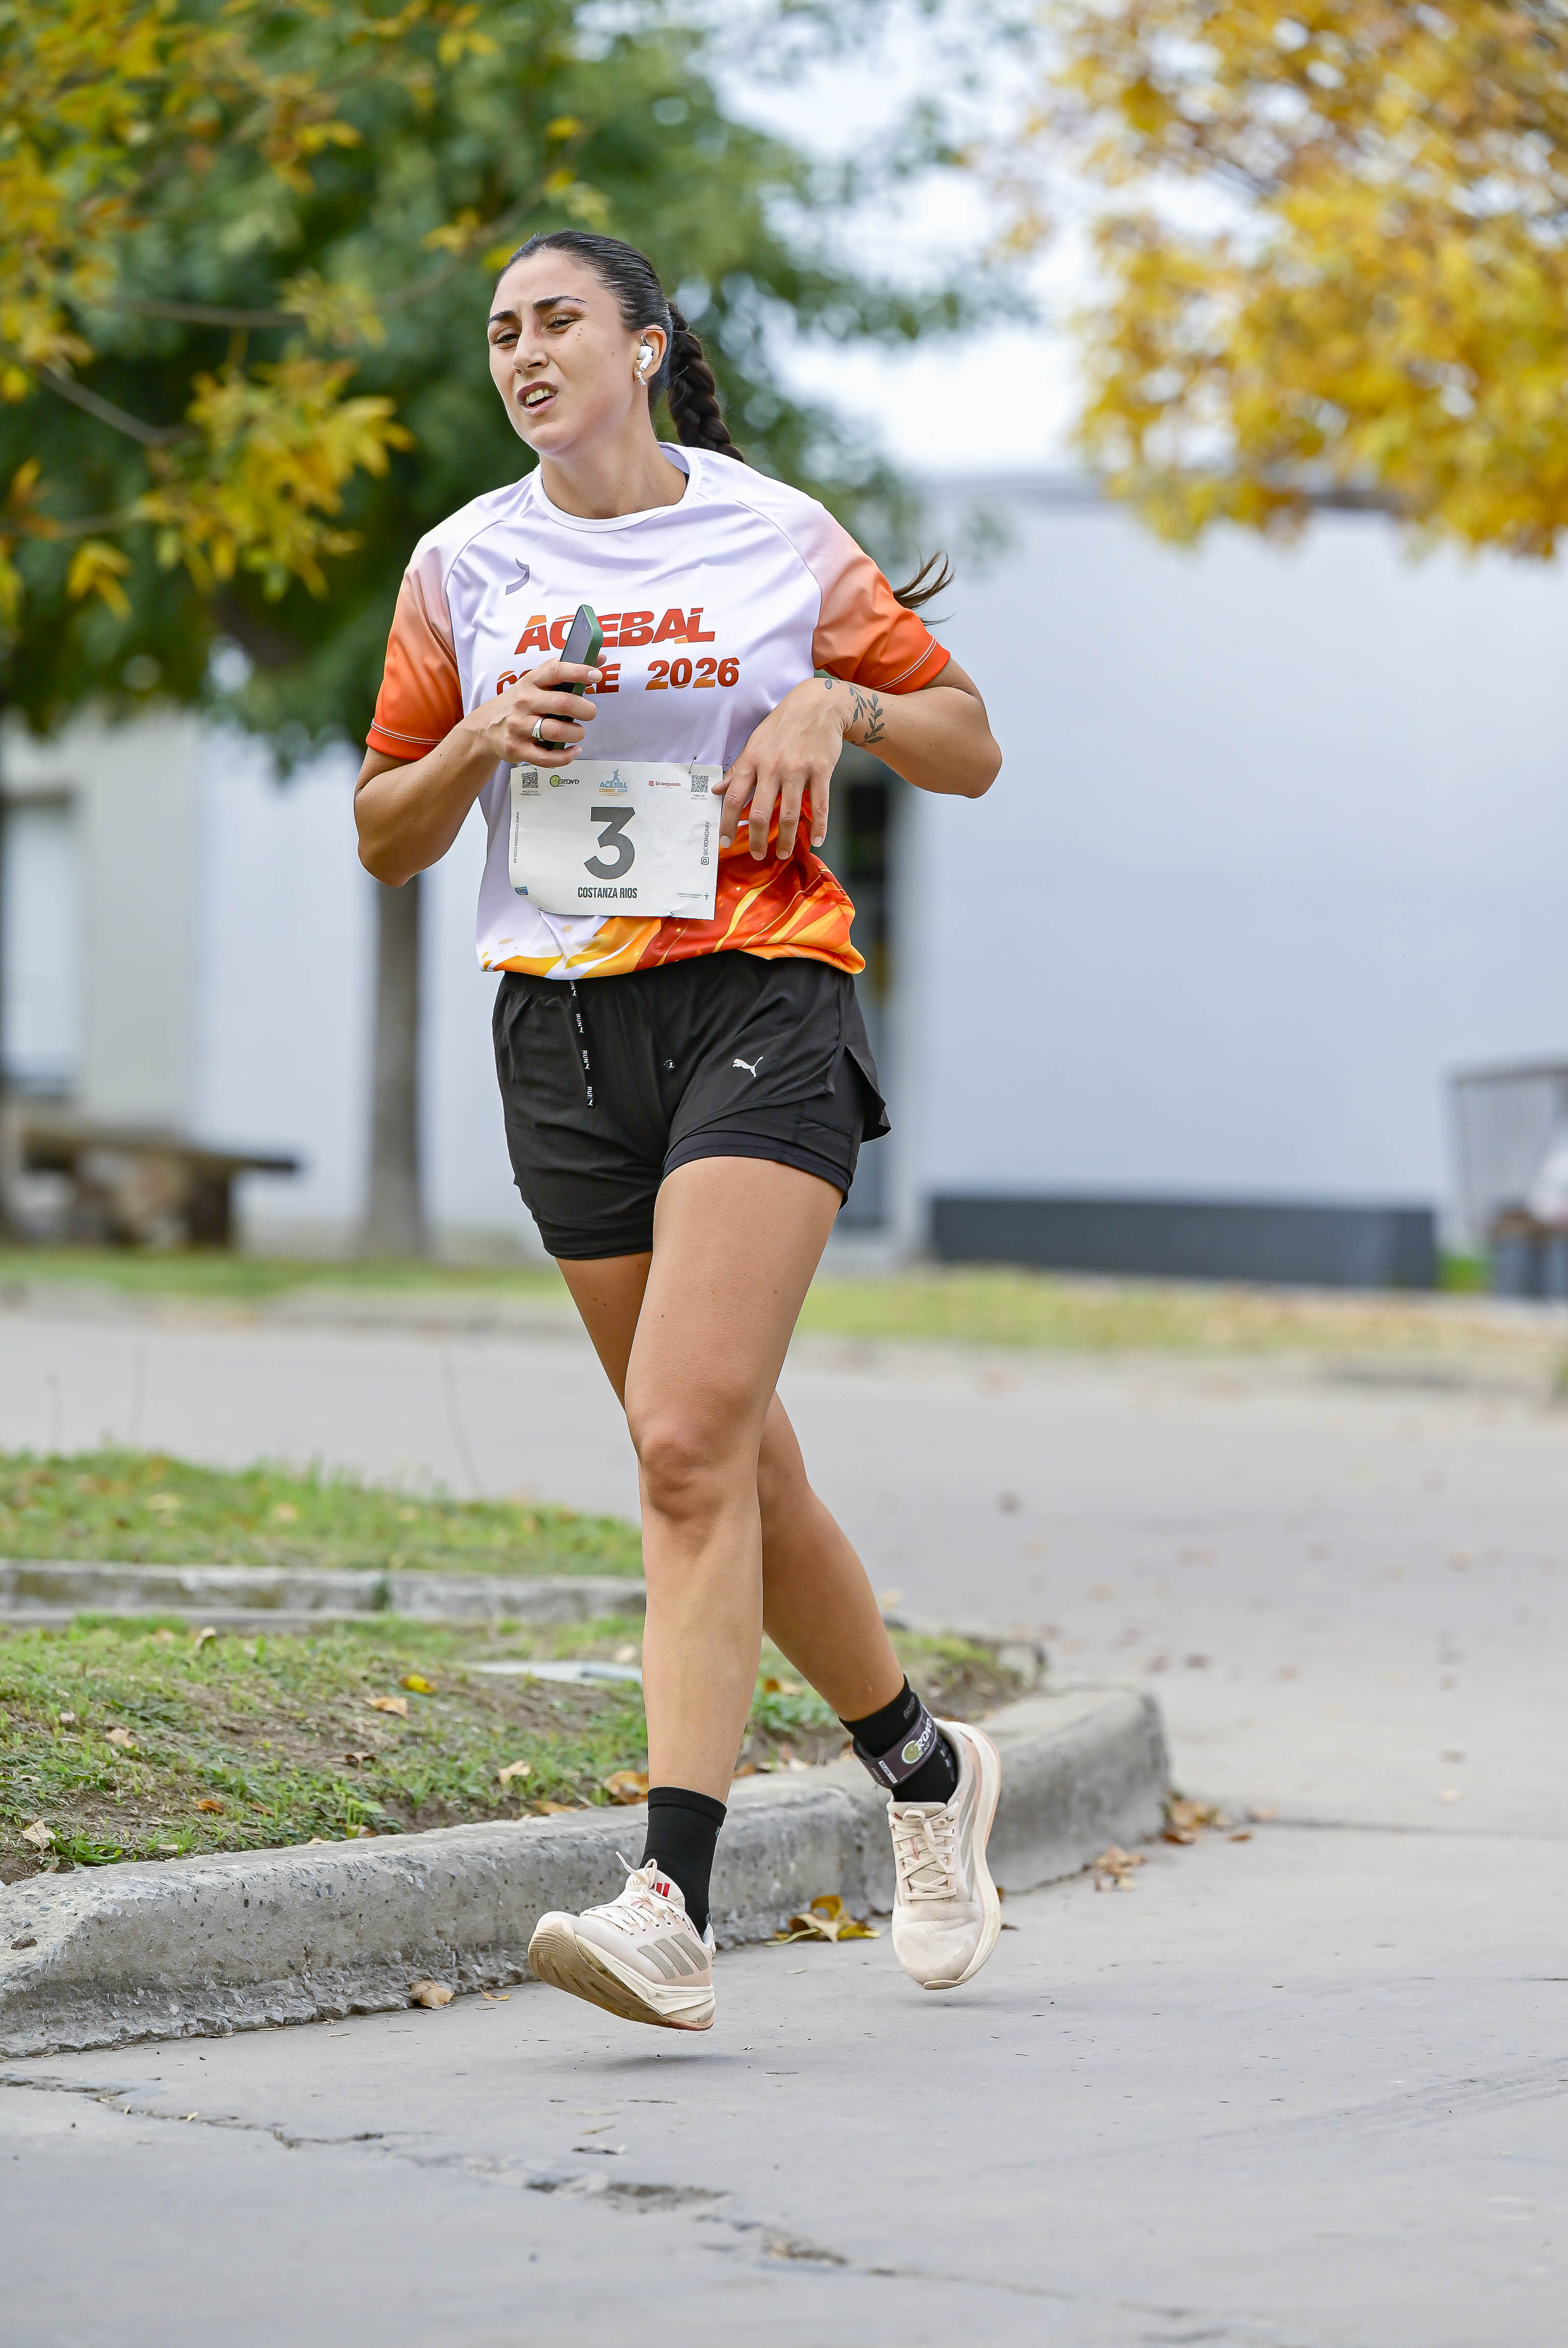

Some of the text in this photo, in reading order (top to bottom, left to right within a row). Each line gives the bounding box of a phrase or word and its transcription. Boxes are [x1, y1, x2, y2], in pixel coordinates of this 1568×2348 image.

[645, 657, 740, 691] 2026
[583, 806, 636, 880] 3
[578, 887, 638, 899] COSTANZA RIOS
